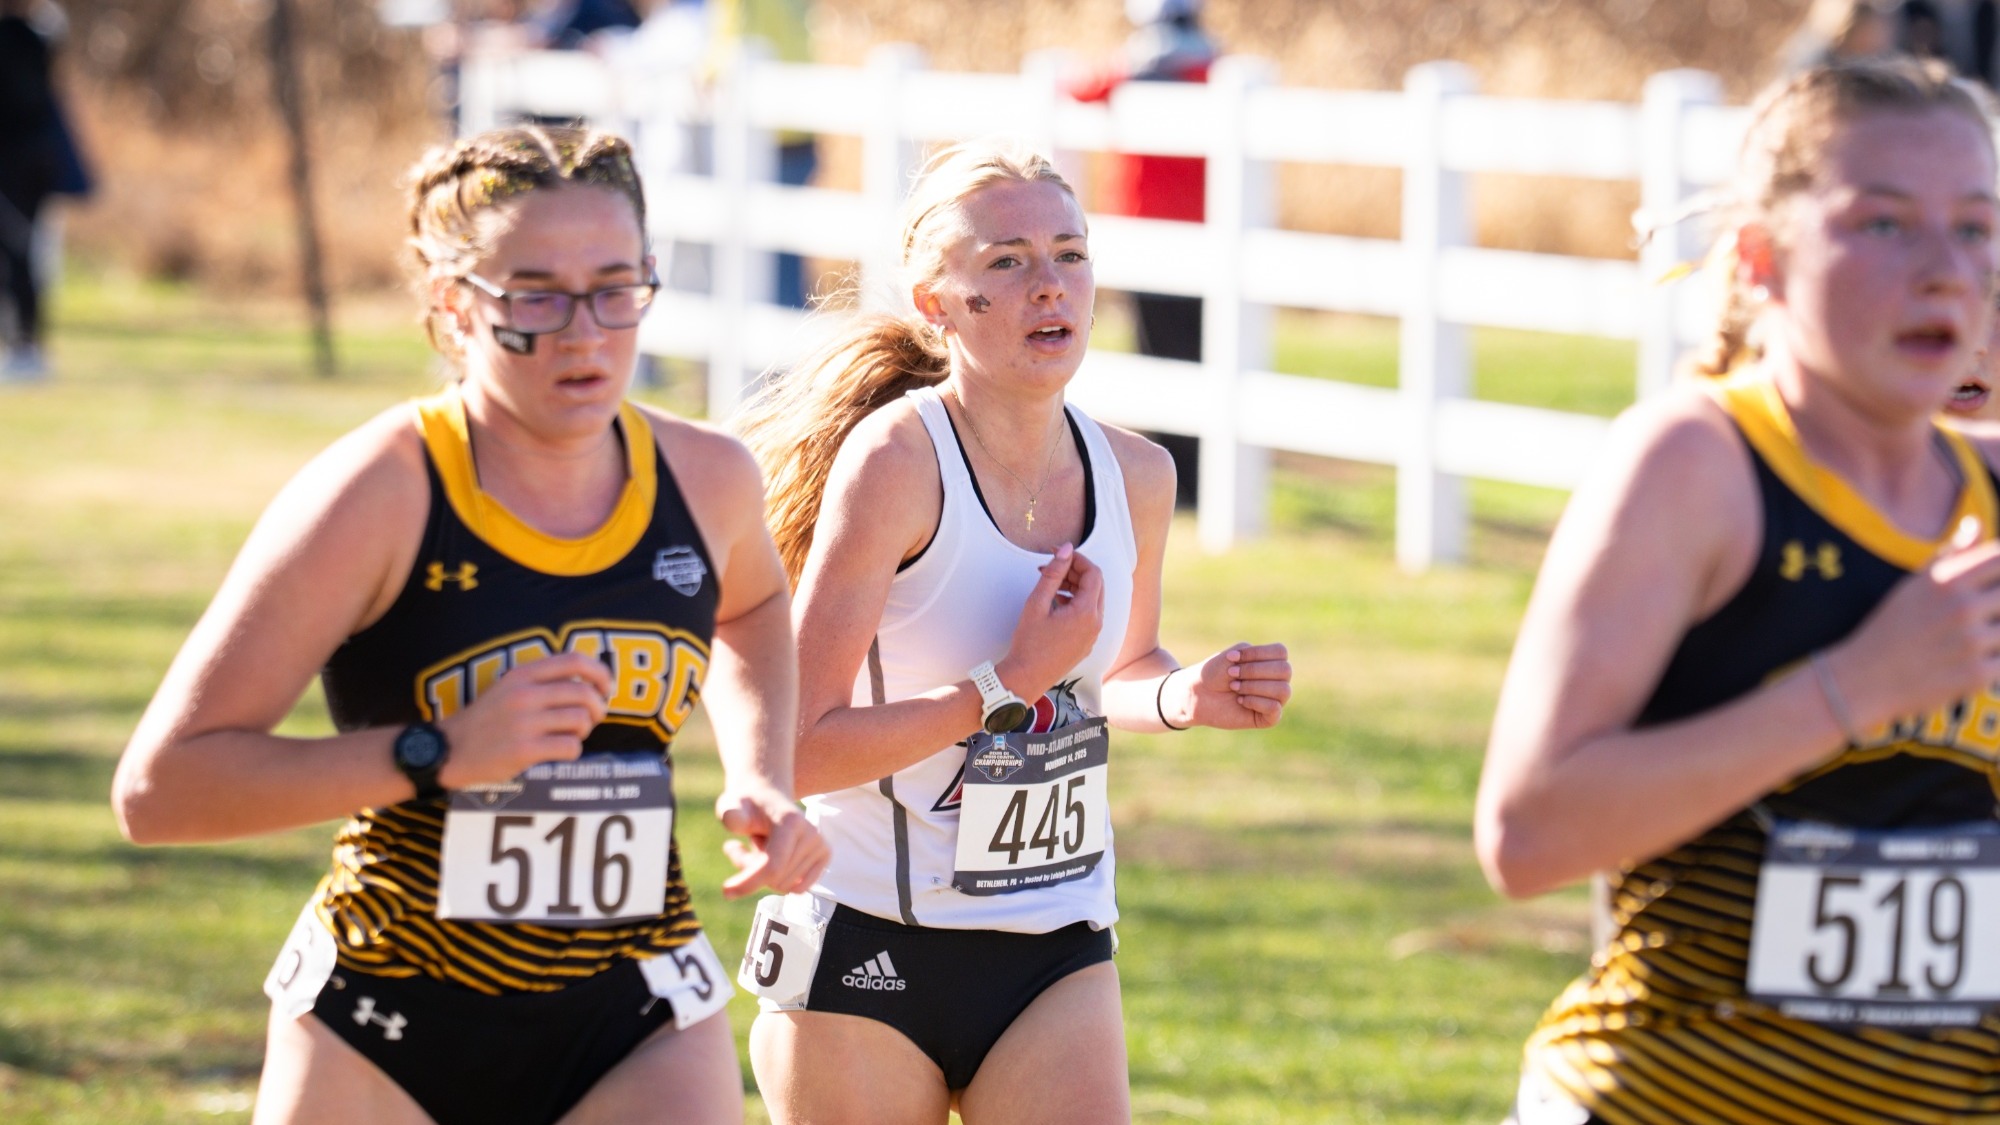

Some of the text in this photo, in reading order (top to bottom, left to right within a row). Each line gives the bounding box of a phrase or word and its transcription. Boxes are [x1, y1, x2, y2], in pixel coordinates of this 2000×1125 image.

[1026, 725, 1102, 756] MID-ATLANTIC REGIONAL
[974, 759, 1023, 767] CHAMPIONSHIPS
[1044, 755, 1067, 772] NOVEMBER
[1074, 747, 1087, 761] 2025
[987, 774, 1086, 865] 445
[485, 813, 636, 918] 516
[976, 865, 1087, 888] BETHLEHEM, PA Hosted by Lehigh University
[1806, 876, 1966, 992] 519
[841, 974, 906, 991] adidas
